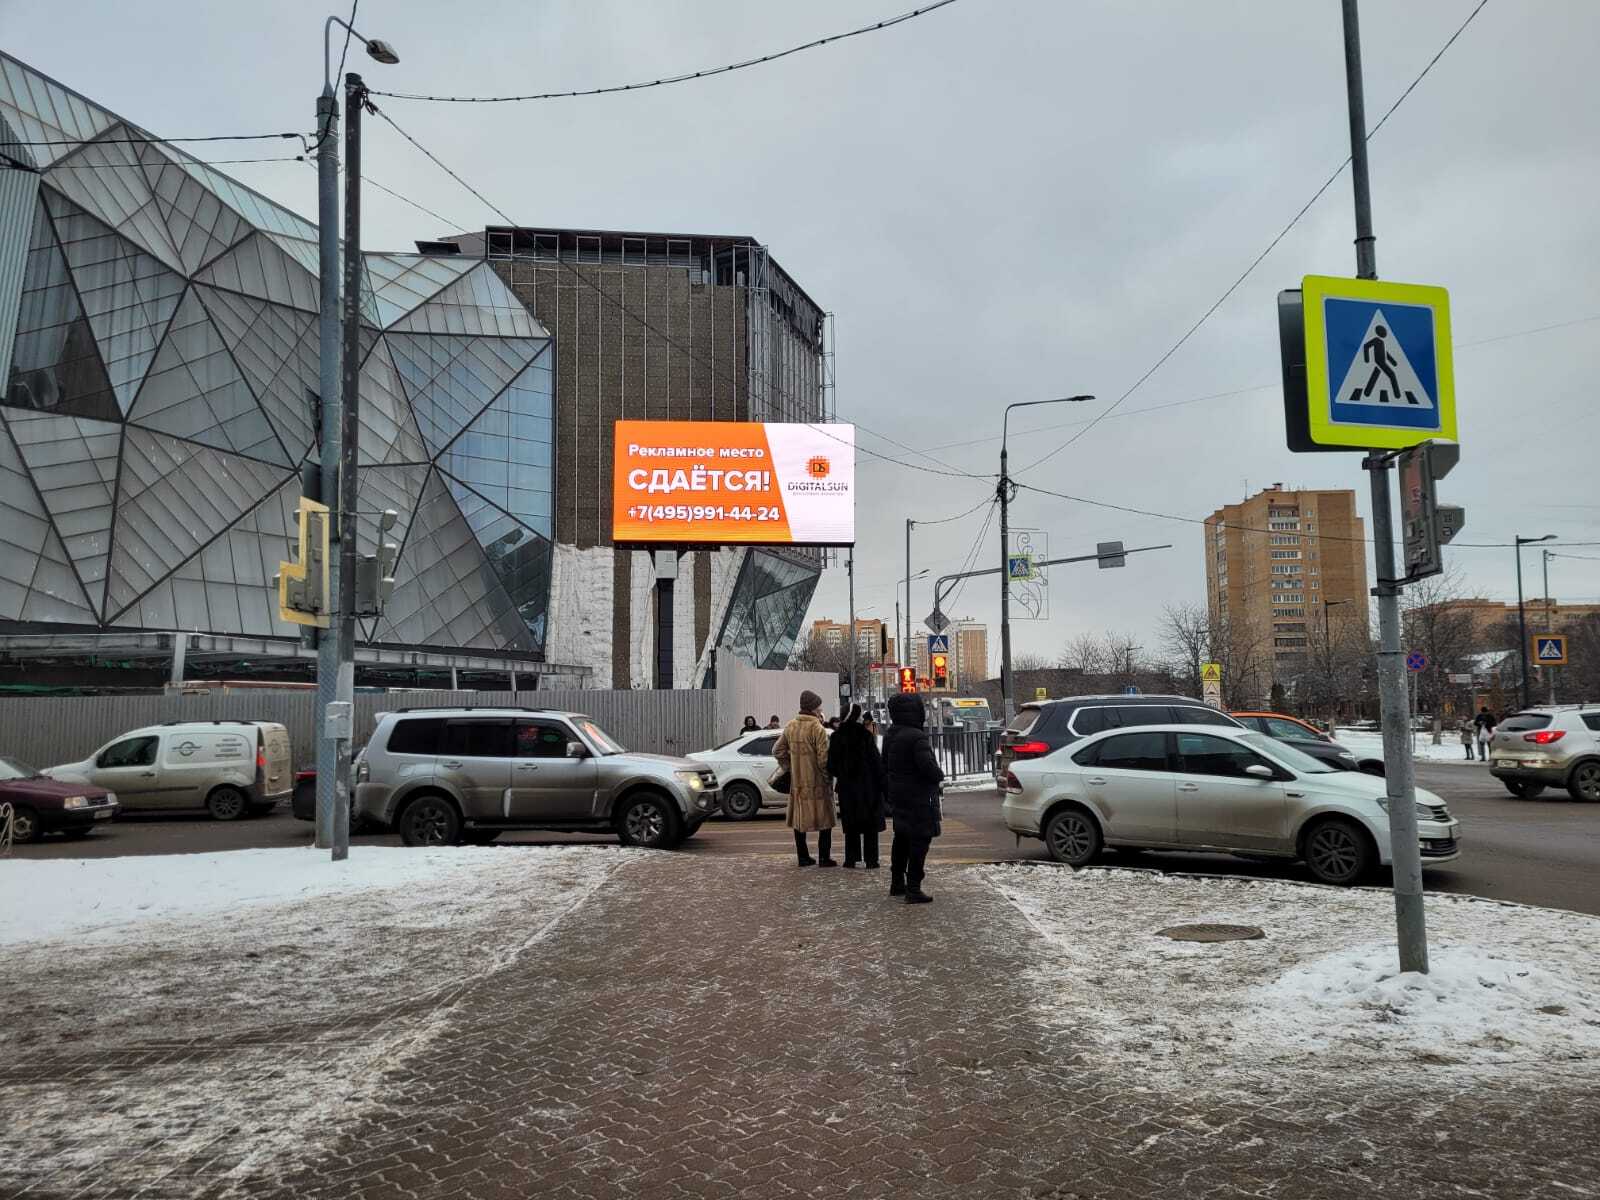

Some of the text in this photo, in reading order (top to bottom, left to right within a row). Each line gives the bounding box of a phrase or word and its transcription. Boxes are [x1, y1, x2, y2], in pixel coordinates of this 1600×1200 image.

[628, 444, 764, 458] Рекламное место
[628, 464, 770, 493] СДАЁТСЯ!
[628, 505, 780, 522] +7(495)991-44-24
